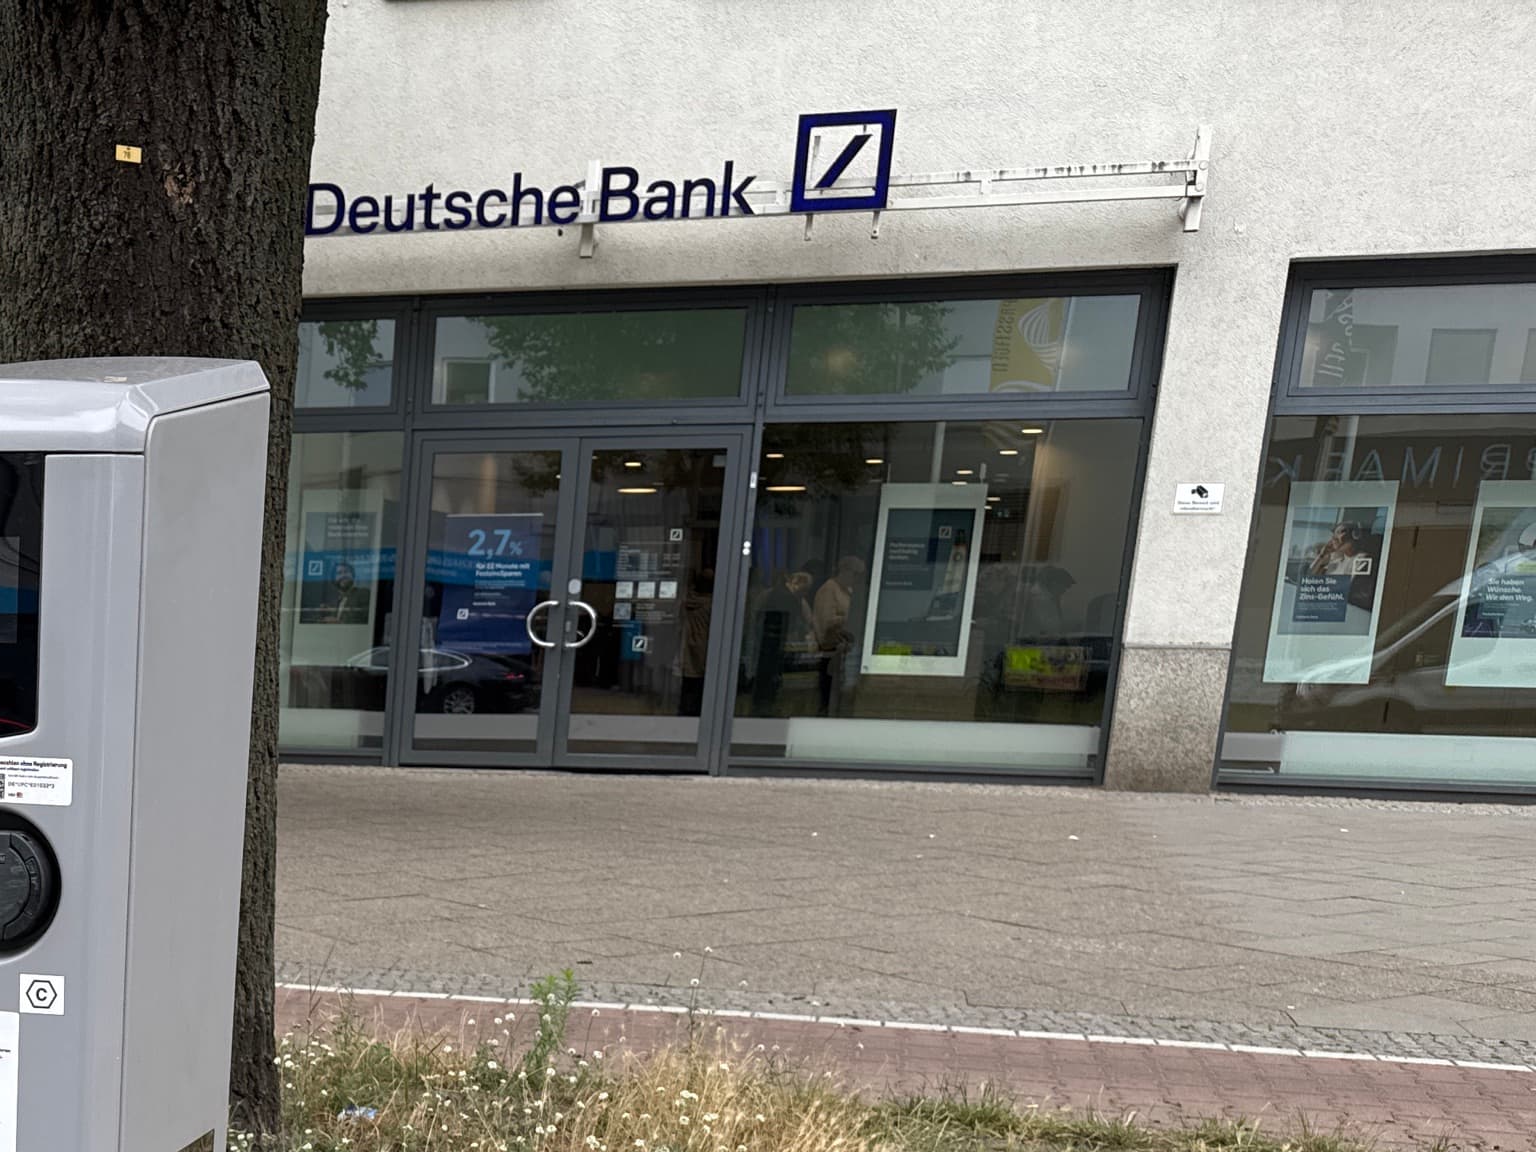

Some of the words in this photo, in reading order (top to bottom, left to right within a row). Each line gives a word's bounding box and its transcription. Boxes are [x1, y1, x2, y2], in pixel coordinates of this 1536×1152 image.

[305, 172, 581, 236] Deutsche
[599, 160, 757, 222] Bank
[1325, 577, 1337, 585] Sie
[1300, 585, 1315, 593] sich
[1316, 585, 1330, 593] das
[33, 761, 67, 769] Registrierung
[36, 988, 47, 1001] C
